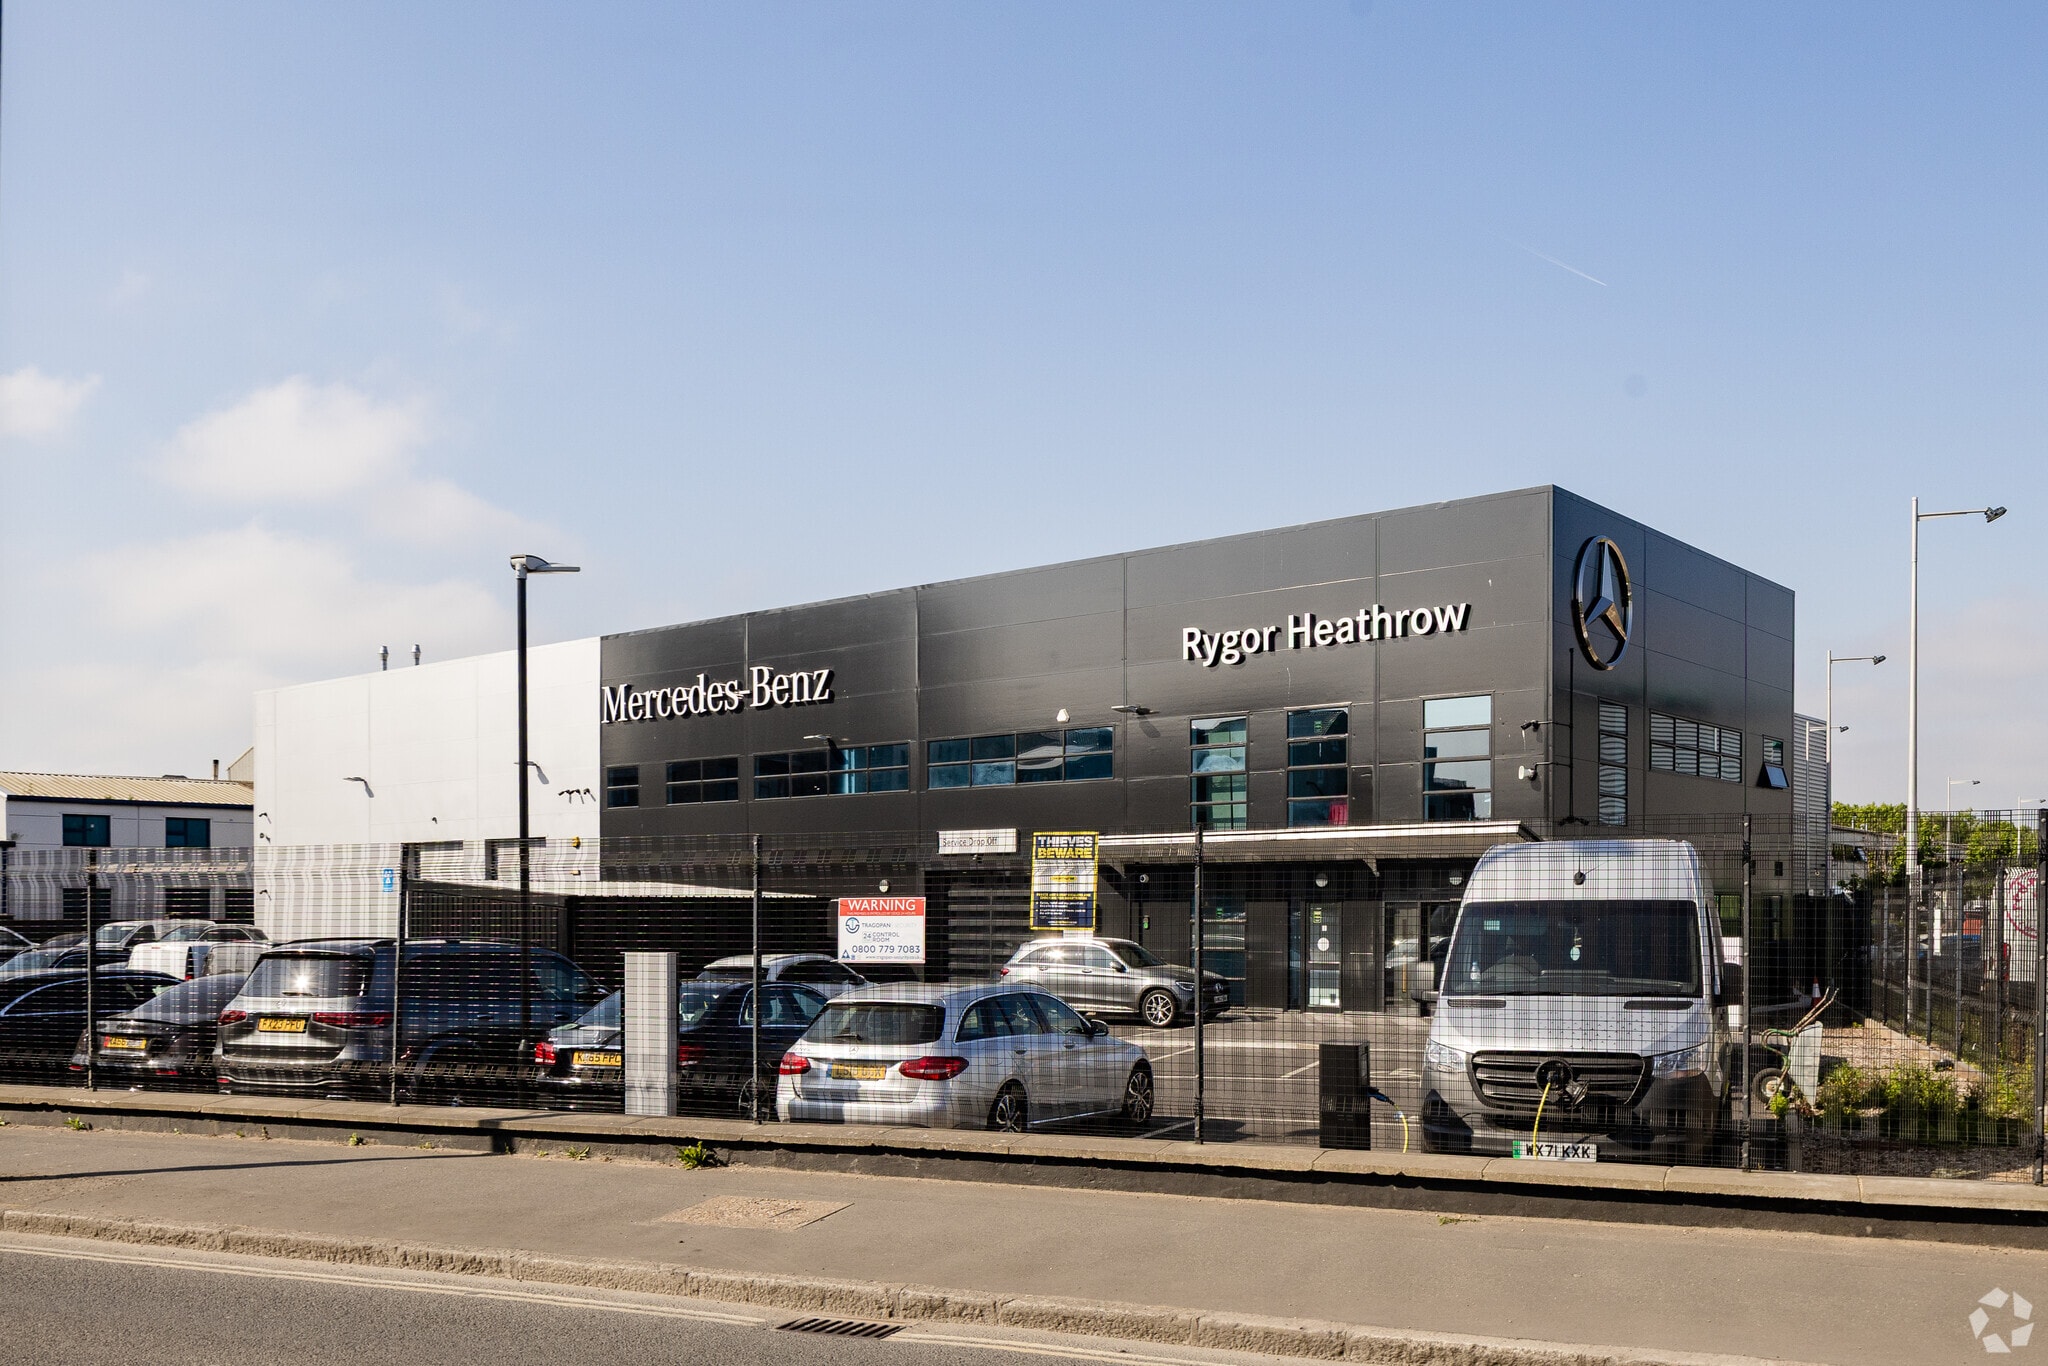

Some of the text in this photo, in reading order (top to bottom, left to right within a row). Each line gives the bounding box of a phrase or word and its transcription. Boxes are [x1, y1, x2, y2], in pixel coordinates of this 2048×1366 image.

[1182, 602, 1470, 667] Rygor Heathrow
[601, 665, 831, 724] Mercedes-Benz
[943, 837, 967, 847] Service
[969, 837, 985, 848] Drop
[1037, 836, 1093, 847] THIEVES
[1037, 847, 1093, 859] BEWARE
[847, 899, 916, 911] WARNING
[852, 945, 920, 953] 0800 779 7083
[1562, 1144, 1591, 1158] KXK
